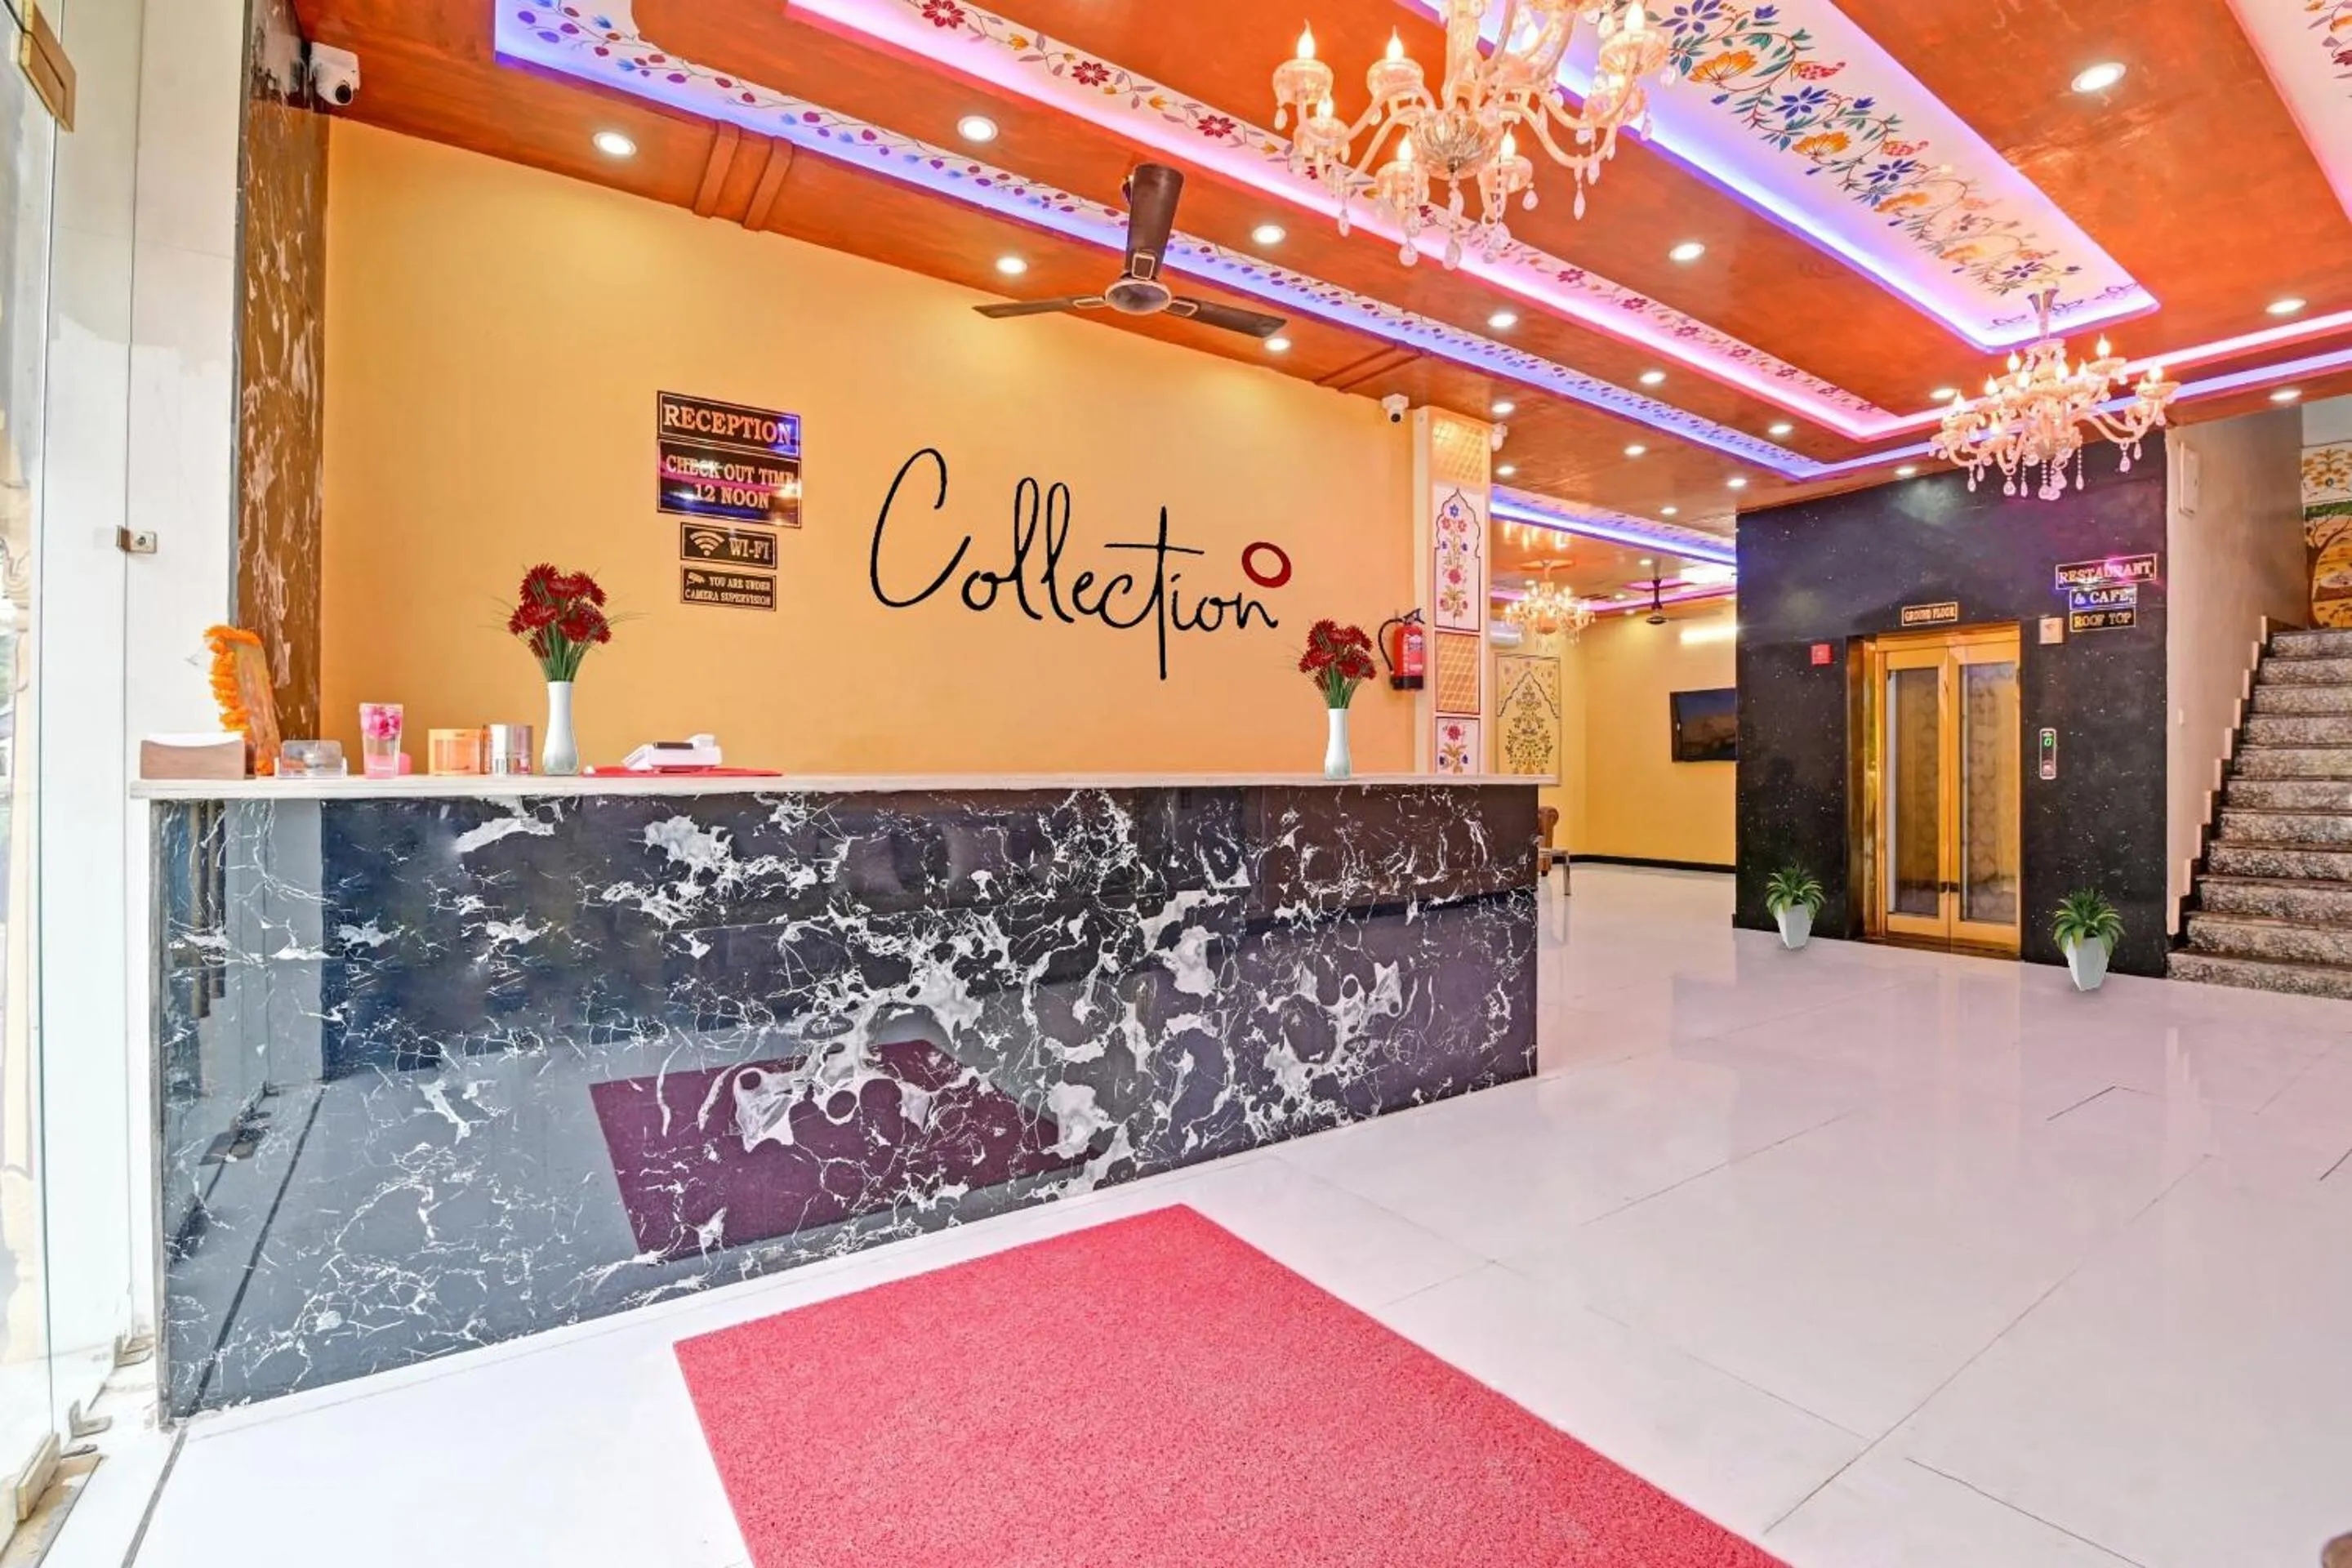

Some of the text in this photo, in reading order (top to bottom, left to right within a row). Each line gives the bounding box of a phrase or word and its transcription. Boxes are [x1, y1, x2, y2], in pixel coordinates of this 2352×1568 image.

[662, 403, 792, 446] RECEPTION
[665, 454, 795, 488] CHECK OUT TIME
[695, 484, 770, 510] 12 NOON
[728, 537, 770, 560] WI-FI
[871, 448, 1279, 680] Collection
[709, 576, 772, 592] YOU ARE UNDER
[684, 588, 772, 606] CAMERA SUPERVISION
[2074, 592, 2087, 605] &
[2074, 612, 2132, 628] ROOF TOP
